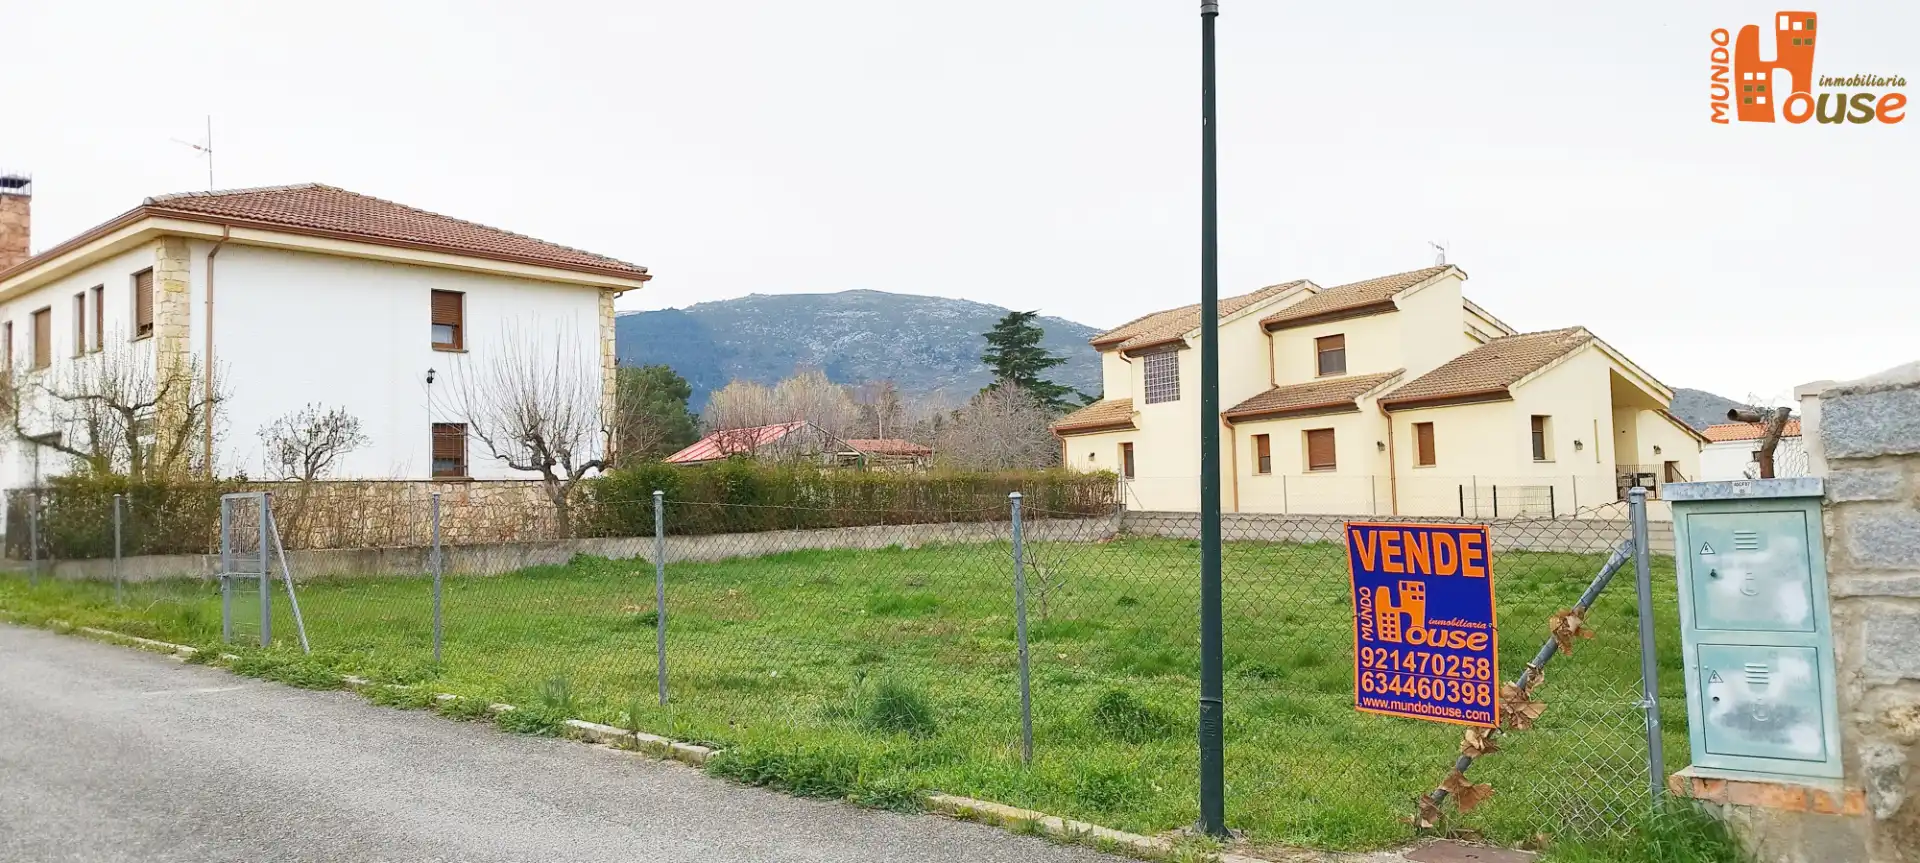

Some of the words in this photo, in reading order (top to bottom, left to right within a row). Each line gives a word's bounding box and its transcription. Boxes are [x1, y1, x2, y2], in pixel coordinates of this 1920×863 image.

[1352, 530, 1485, 578] VENDE
[1359, 587, 1373, 641] MUNDO
[1428, 617, 1487, 629] inmobiliaria
[1361, 647, 1490, 680] 921470258
[1361, 671, 1491, 707] 634460398
[1362, 697, 1490, 721] www.mundohouse.com
